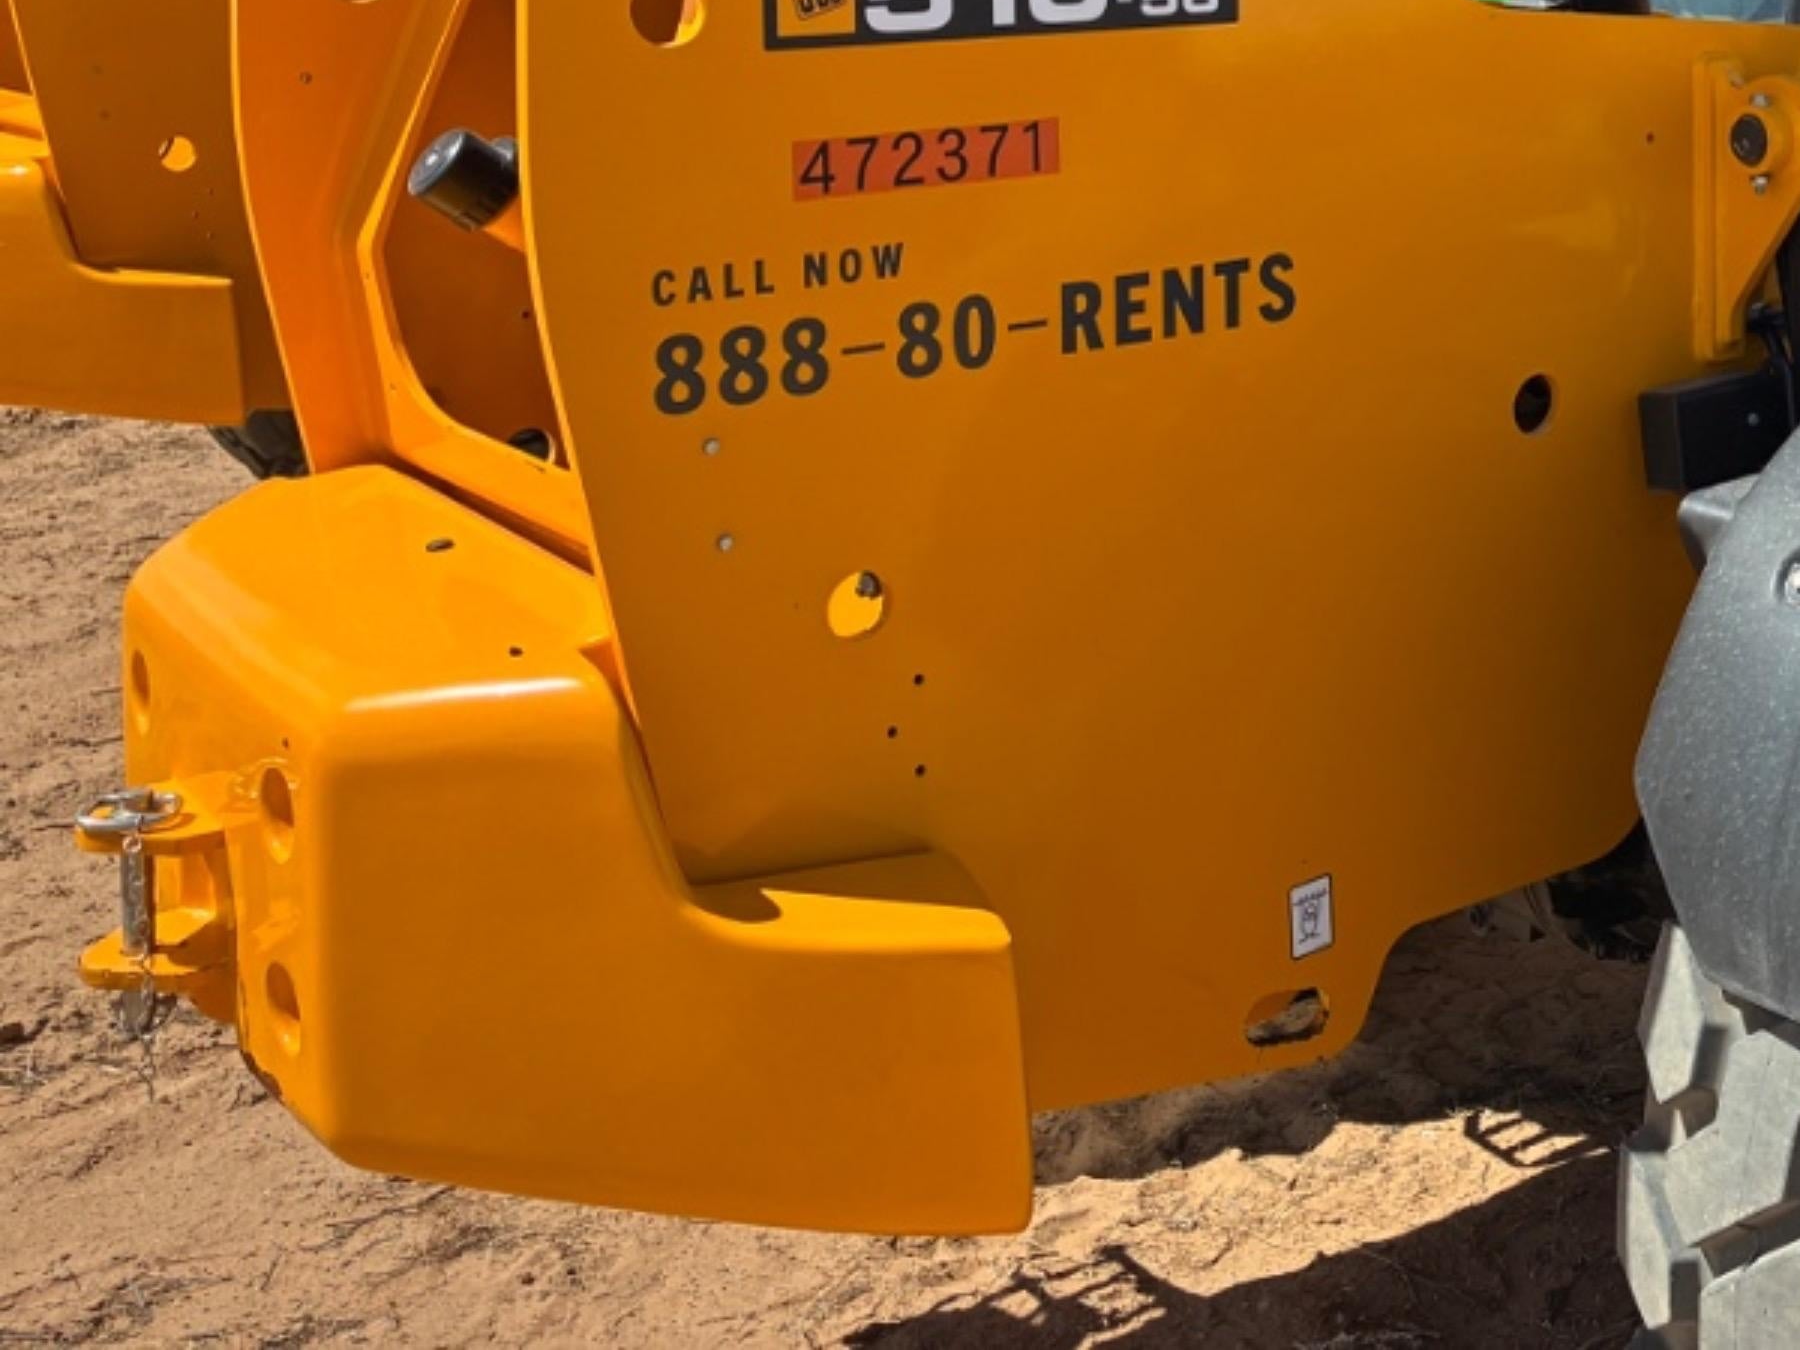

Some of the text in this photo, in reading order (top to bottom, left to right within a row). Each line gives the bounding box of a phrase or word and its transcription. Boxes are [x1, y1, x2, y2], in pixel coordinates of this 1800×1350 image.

[798, 119, 1043, 196] 472371
[651, 243, 905, 307] CALL NOW
